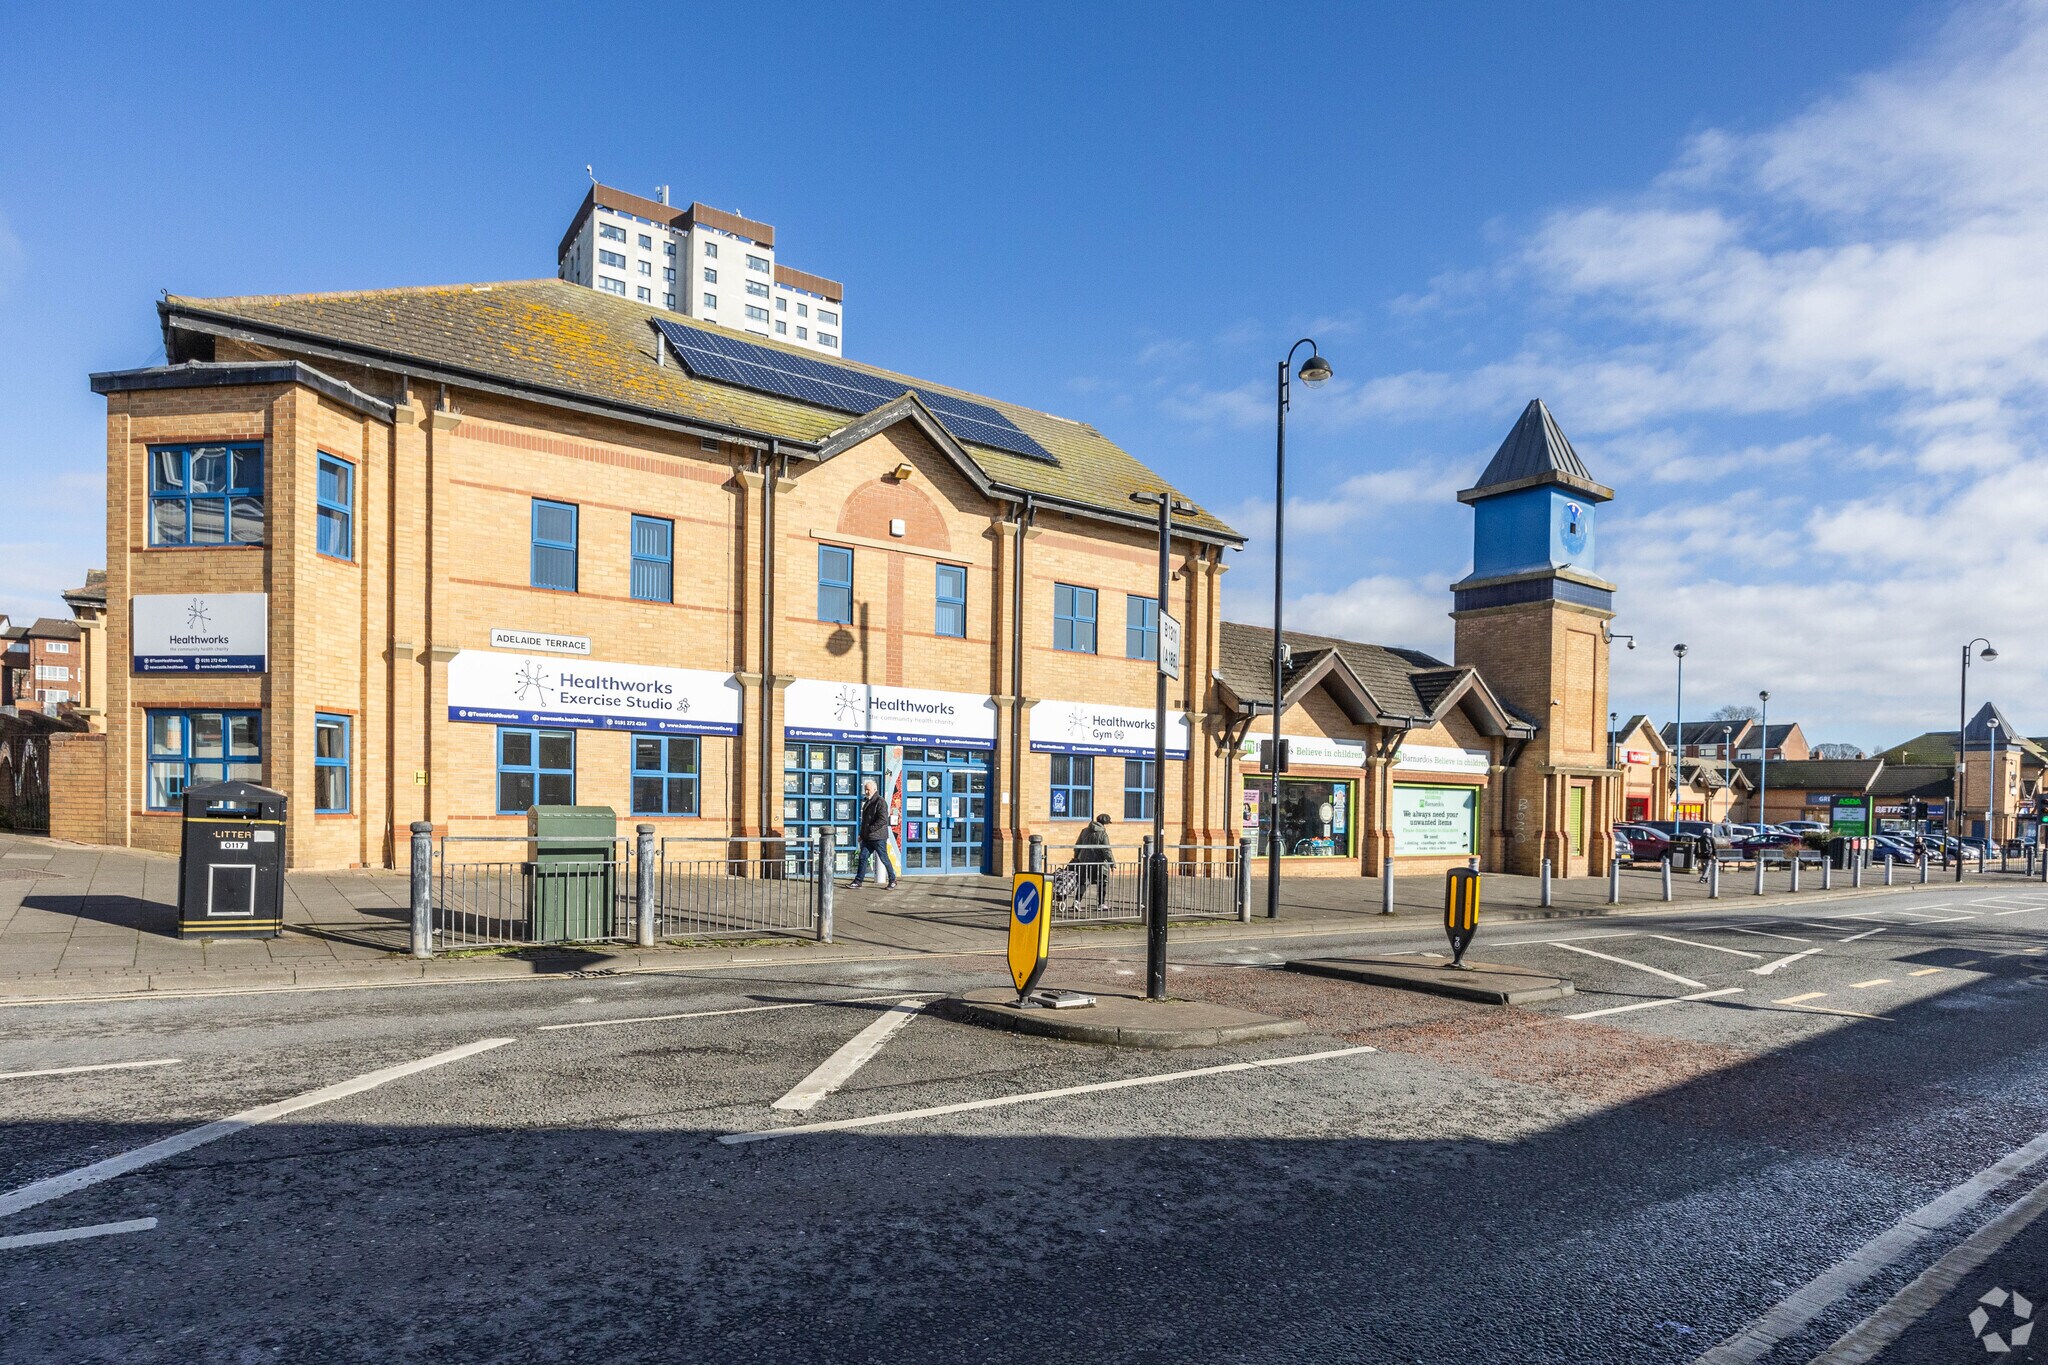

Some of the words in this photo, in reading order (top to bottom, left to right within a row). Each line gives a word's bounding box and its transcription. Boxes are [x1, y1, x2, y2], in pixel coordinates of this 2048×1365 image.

[169, 635, 229, 645] Healthworks
[496, 634, 541, 646] ADELAIDE
[545, 638, 586, 650] TERRACE
[560, 673, 673, 694] Healthworks
[560, 691, 621, 707] Exercise
[626, 695, 673, 710] Studio
[869, 696, 955, 715] Healthworks
[467, 711, 519, 720] @TeamHealthworks
[540, 715, 594, 724] newcastle.healthworks
[880, 715, 914, 723] community
[934, 717, 954, 726] charity
[1092, 715, 1156, 730] Healthworks
[1092, 728, 1112, 741] Gym
[1296, 746, 1323, 757] Believe
[1324, 748, 1332, 757] in
[1333, 749, 1363, 759] children
[1402, 752, 1433, 764] Barnardo's
[1434, 756, 1456, 766] Believe
[1456, 758, 1463, 766] in
[1464, 758, 1488, 767] children
[416, 772, 427, 784] H
[1412, 811, 1431, 819] always
[1874, 806, 1917, 814] BETFRD
[215, 830, 252, 839] LITTER
